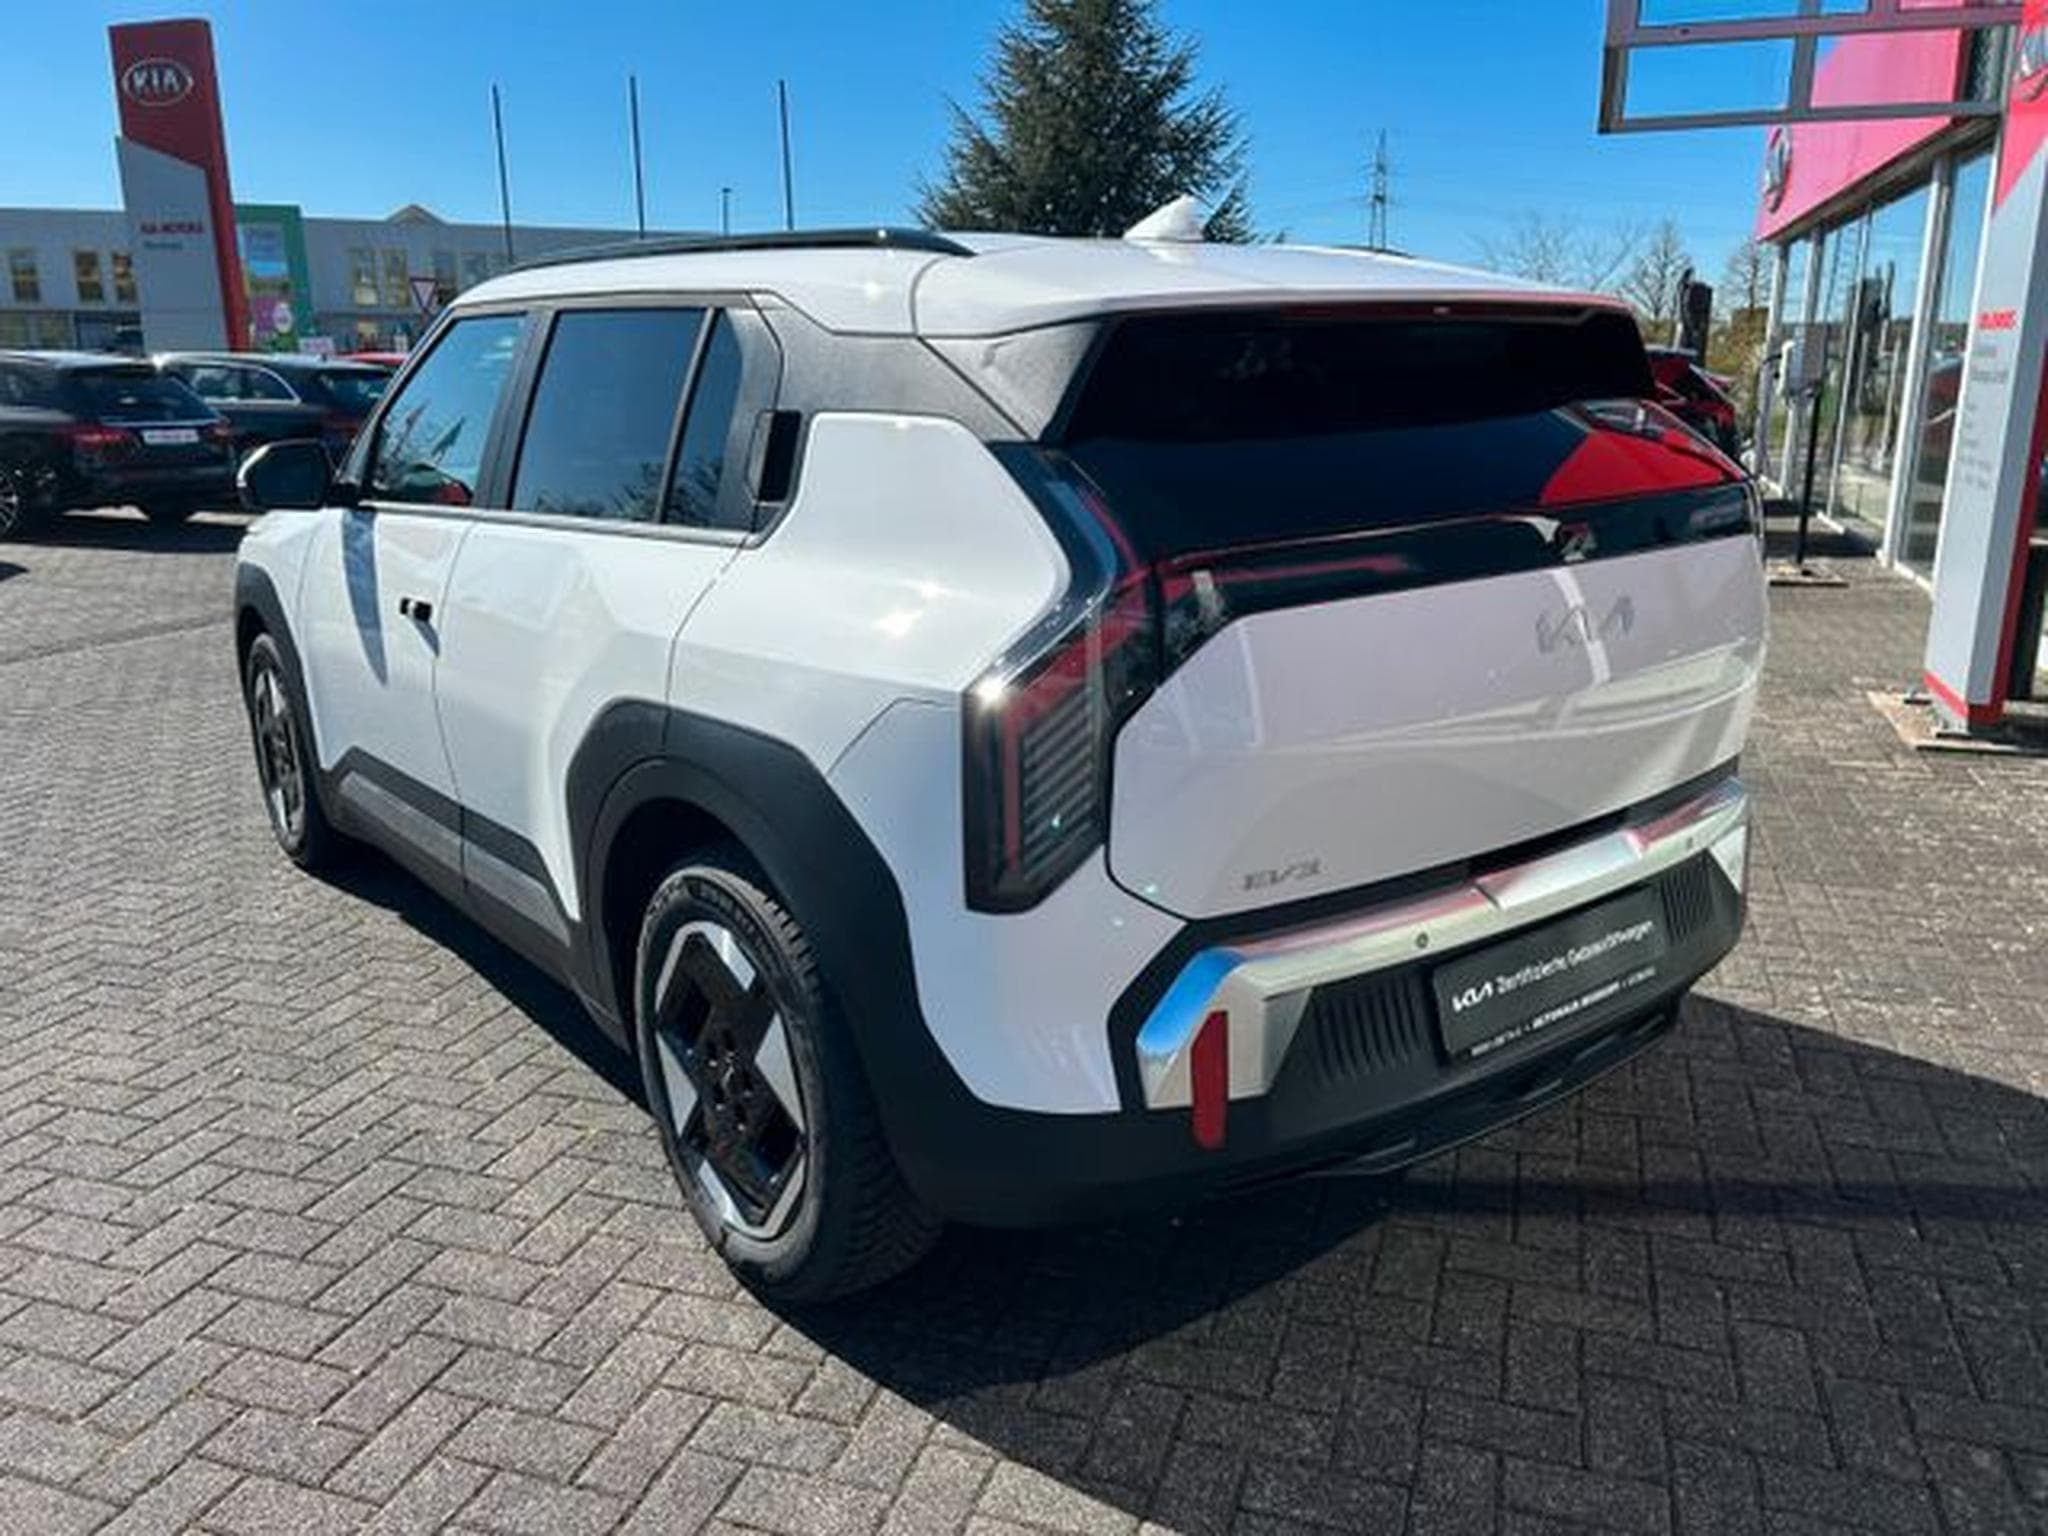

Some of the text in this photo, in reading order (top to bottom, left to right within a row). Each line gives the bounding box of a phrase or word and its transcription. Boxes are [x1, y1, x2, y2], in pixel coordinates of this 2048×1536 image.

[132, 67, 180, 96] KIA
[1535, 595, 1635, 654] KIA
[1243, 857, 1322, 890] EV3
[1451, 981, 1494, 1013] KIA
